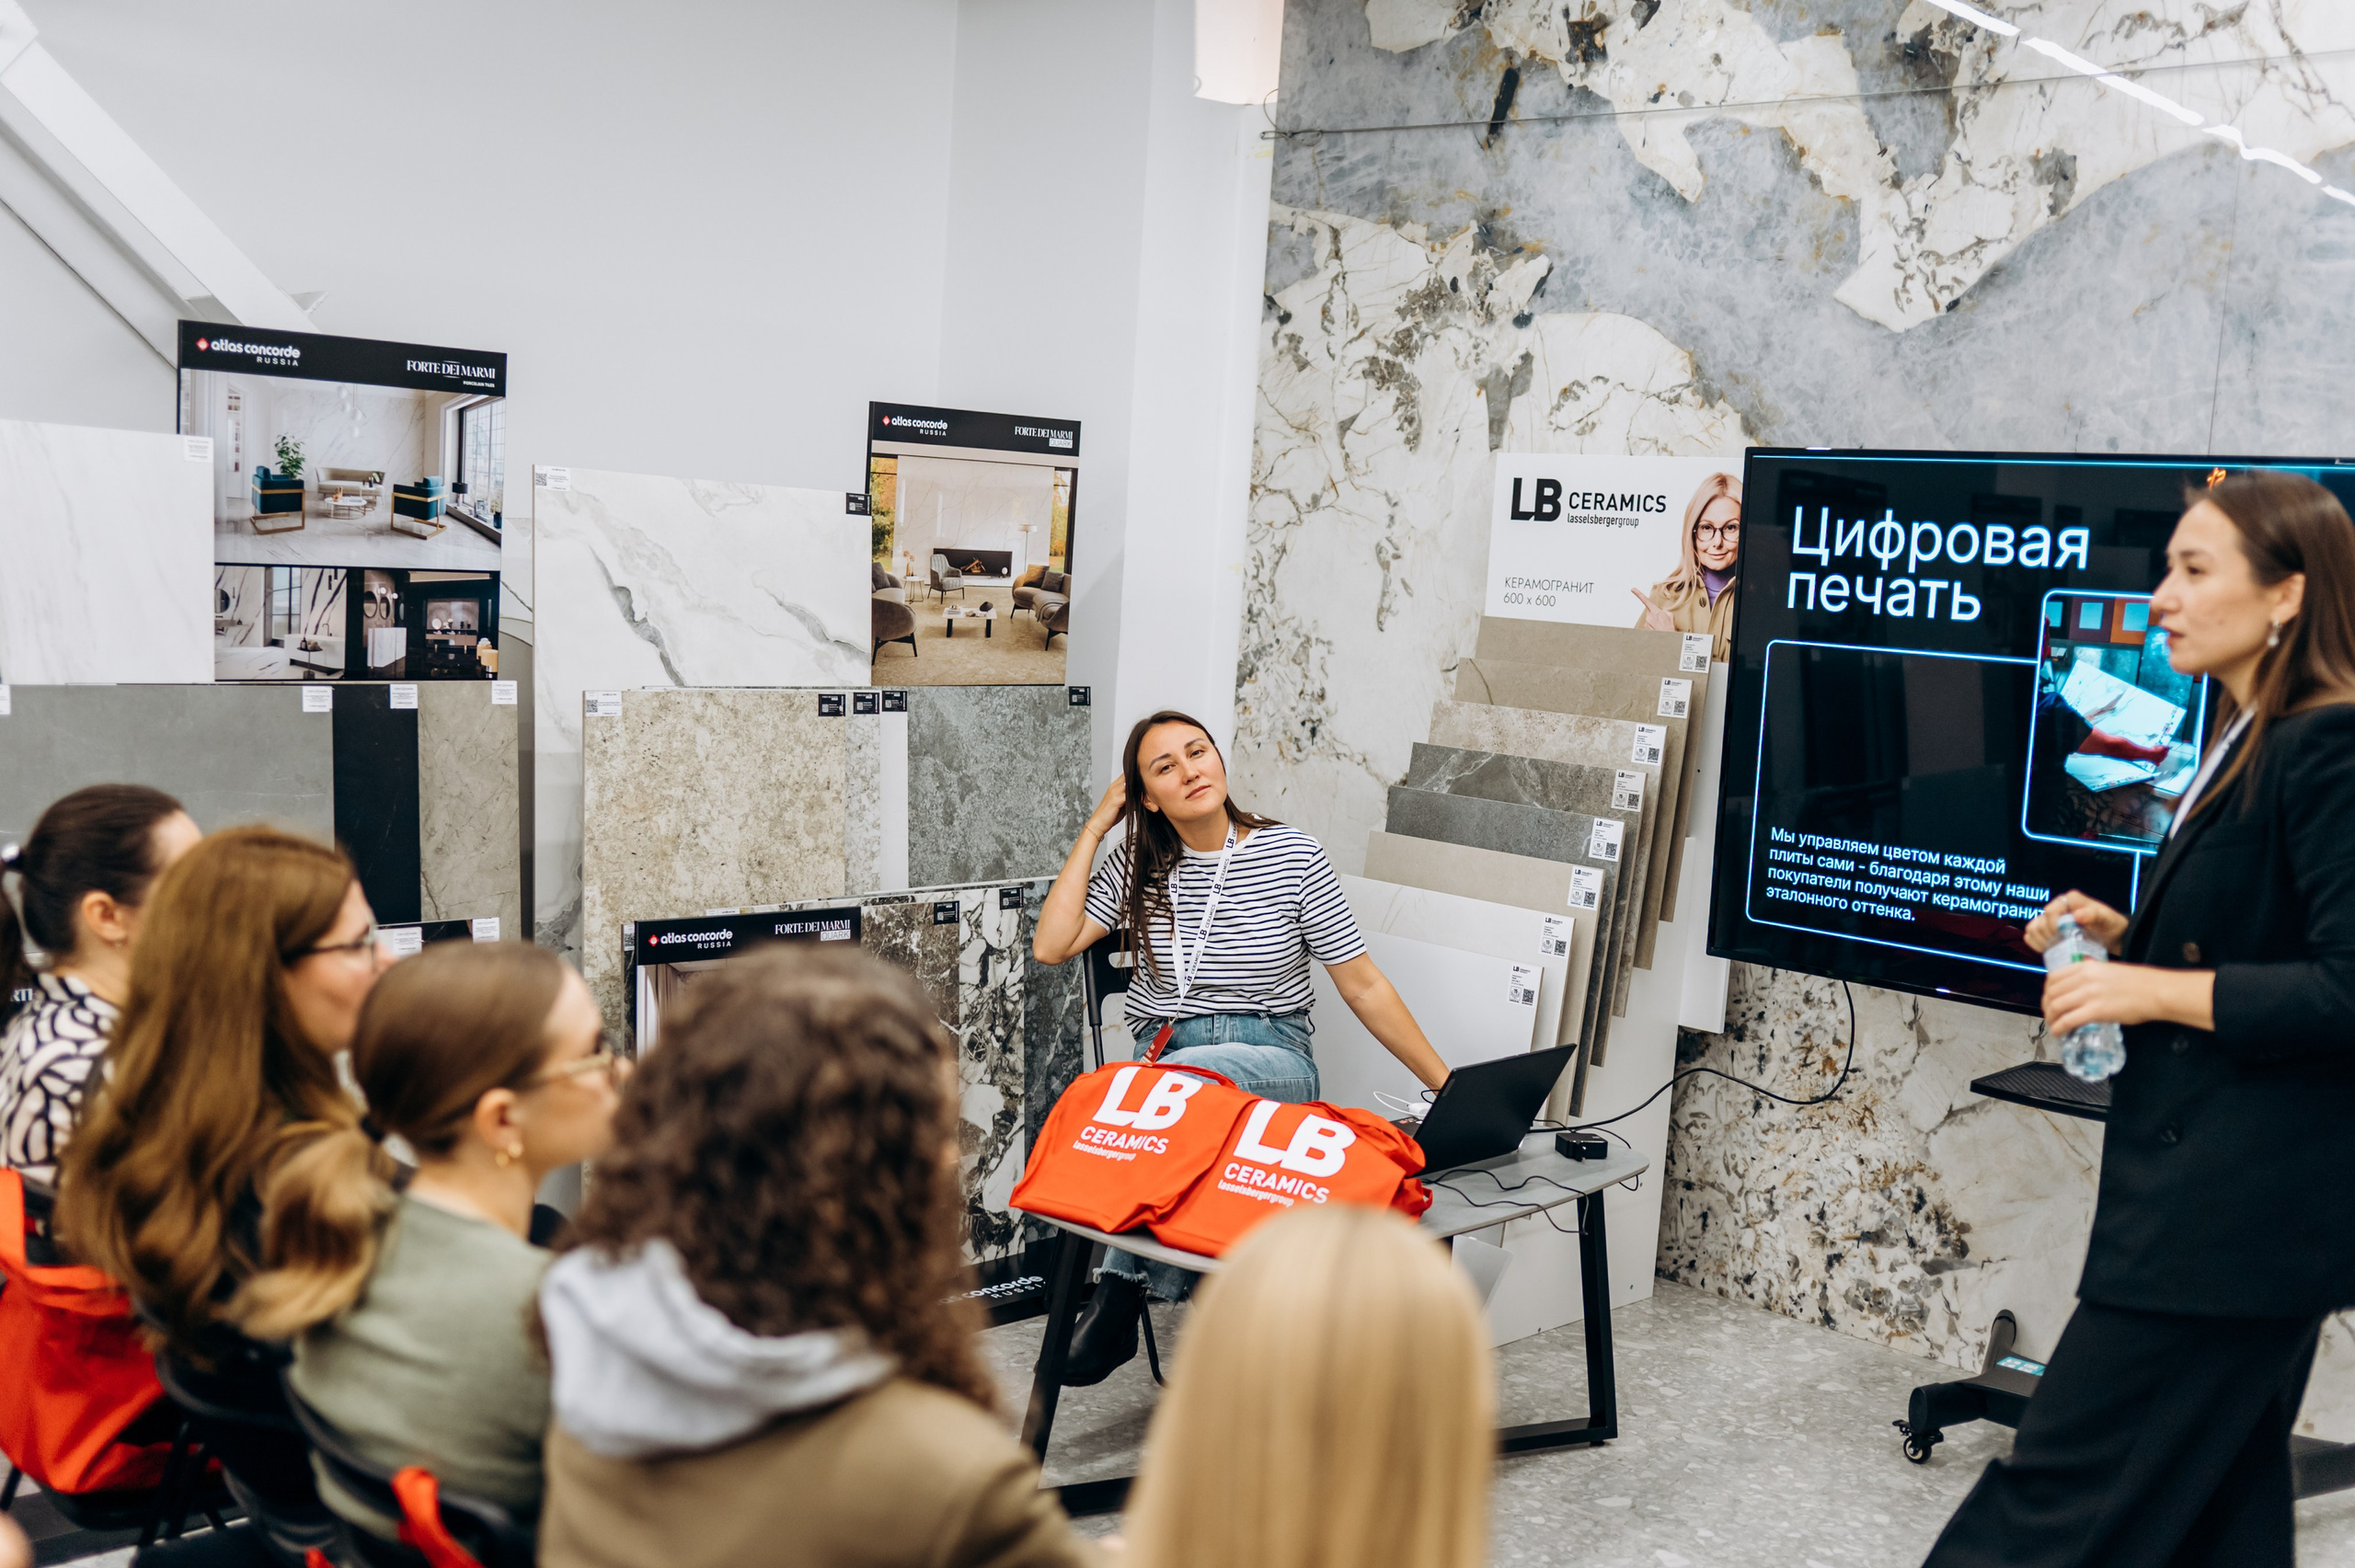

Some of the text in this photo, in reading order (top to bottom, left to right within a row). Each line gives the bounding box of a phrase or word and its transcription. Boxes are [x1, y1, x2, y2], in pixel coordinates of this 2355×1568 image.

[211, 338, 301, 359] atlas concorde
[257, 356, 299, 367] RUSSIA
[407, 360, 496, 379] FORTE DEI MARMI
[891, 416, 948, 429] atlas concorde
[920, 429, 947, 437] RUSSIA
[1015, 426, 1074, 440] FORTE DEI MARMI
[1050, 439, 1072, 448] QUARK
[1511, 477, 1667, 522] LB CERAMICS
[1567, 513, 1639, 529] lasselsbergergroup
[1792, 506, 2090, 574] Цифровая
[1504, 577, 1594, 594] КЕРАМОГРАНИТ
[1503, 592, 1524, 604] 600
[1534, 594, 1557, 607] 600
[1787, 572, 1982, 623] печать
[1225, 838, 1235, 849] LB
[1771, 827, 2006, 875] Мы управляем цветом каждой
[1212, 858, 1230, 895] LB CERAMICS
[1767, 866, 1852, 891] покупатели
[1855, 879, 1929, 903] получают
[1769, 848, 1814, 865] плиты
[1817, 855, 1855, 872] сами
[1869, 860, 1950, 887] благодаря
[1953, 876, 2003, 898] этому
[2005, 883, 2051, 901] наши
[1170, 883, 1178, 894] LB
[1765, 886, 1916, 921] эталонного оттенка.
[775, 919, 851, 935] FORTE DEI MARMI
[1198, 904, 1216, 941] LB CERAMICS
[661, 928, 733, 944] atlas concorde
[821, 930, 850, 940] QUARK
[697, 941, 731, 950] RUSSIA
[1190, 950, 1201, 975] CERAMICS
[1092, 1066, 1203, 1130] LB
[1080, 1126, 1169, 1154] CERAMICS
[1233, 1099, 1357, 1178] LB
[1223, 1162, 1330, 1204] CERAMICS
[961, 1276, 1043, 1299] concorde
[991, 1281, 1046, 1299] RUSSI
